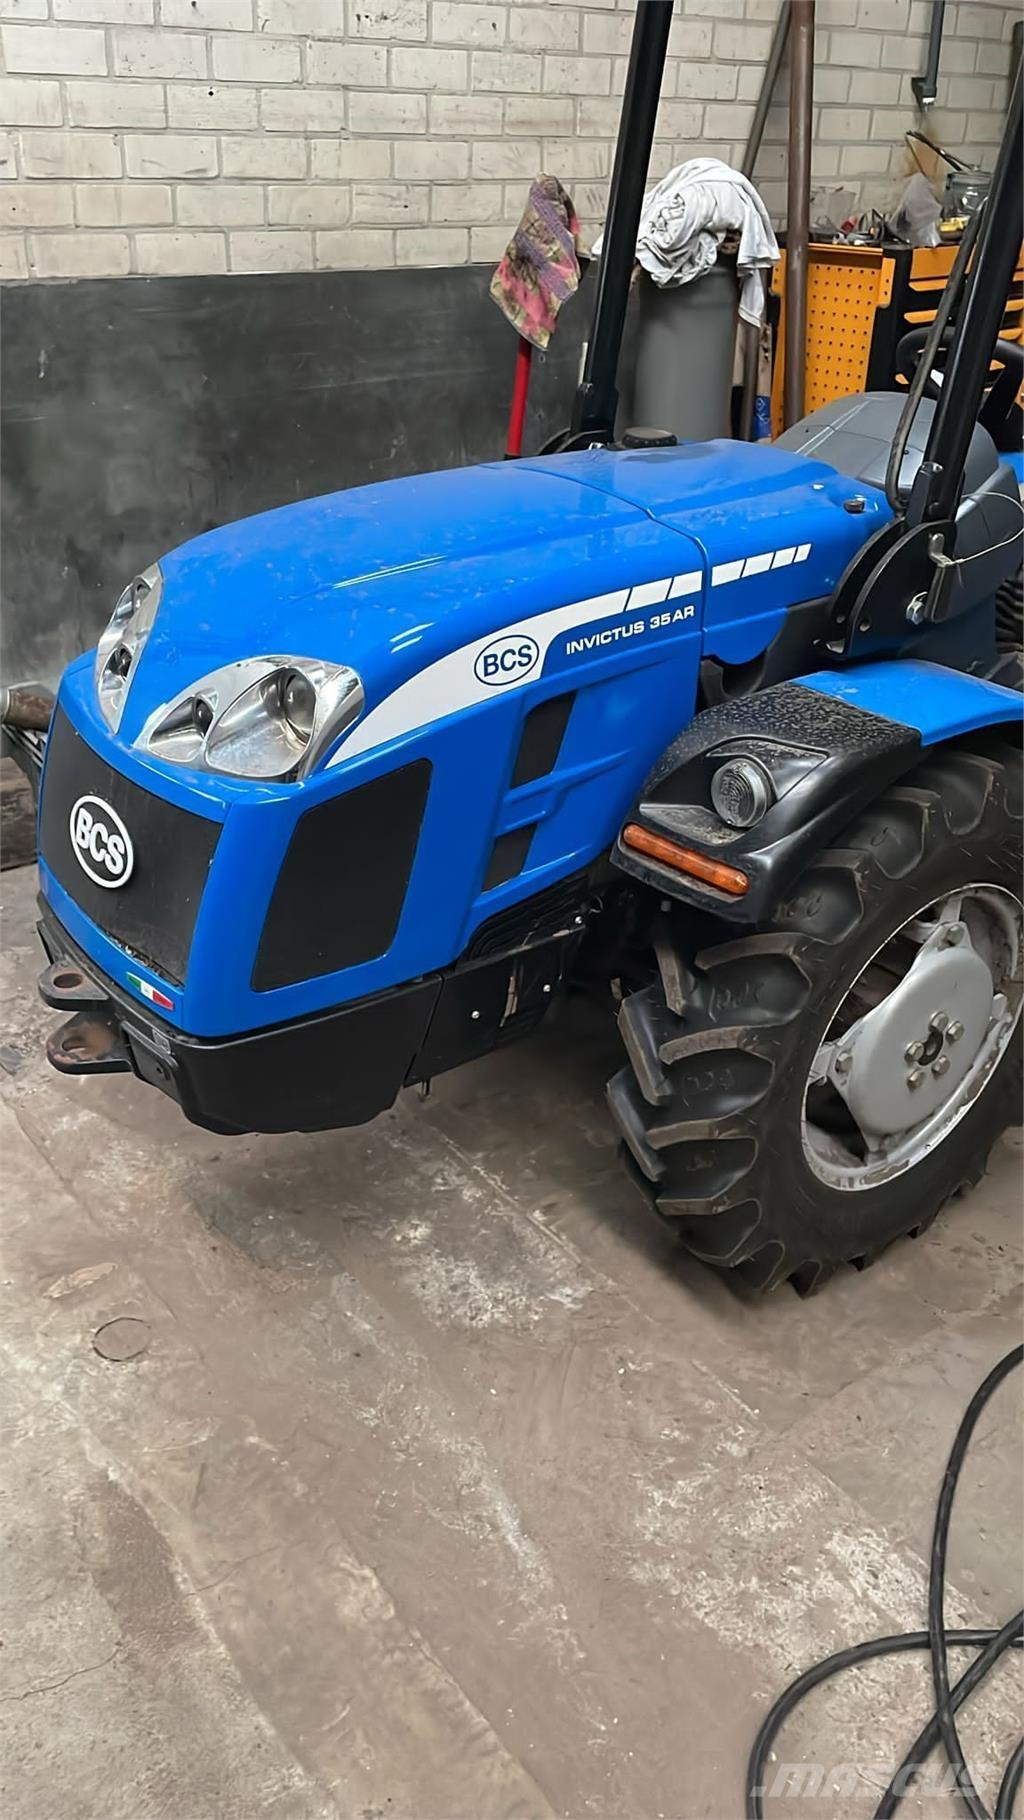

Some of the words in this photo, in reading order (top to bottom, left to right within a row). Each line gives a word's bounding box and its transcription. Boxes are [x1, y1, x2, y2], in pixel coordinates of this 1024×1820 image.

[566, 621, 645, 655] INVICTUS
[483, 644, 533, 677] BCS
[75, 807, 125, 875] BCS
